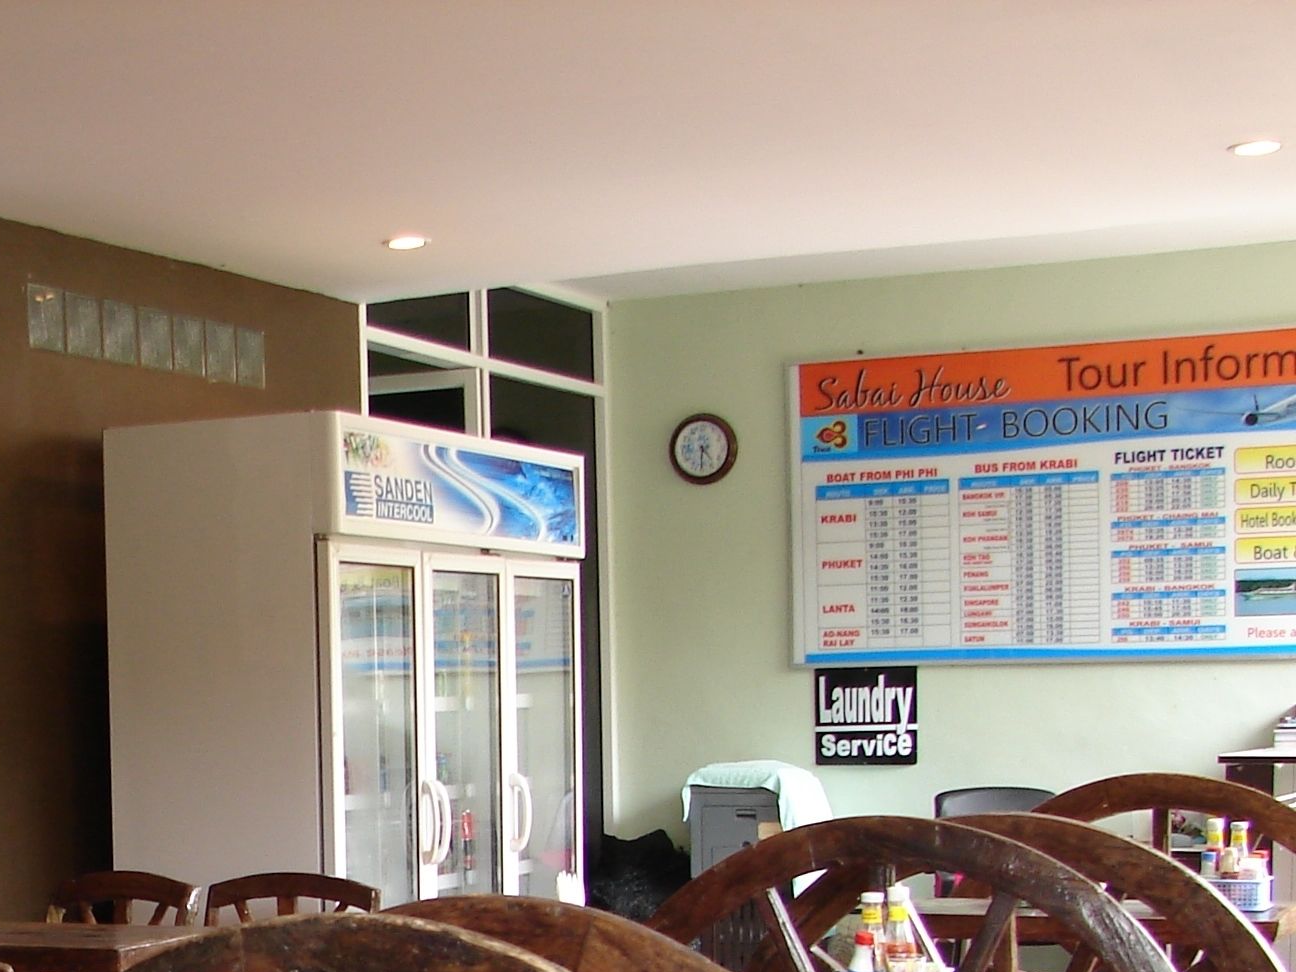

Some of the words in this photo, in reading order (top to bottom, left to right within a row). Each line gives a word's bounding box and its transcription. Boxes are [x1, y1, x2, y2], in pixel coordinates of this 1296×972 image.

[1058, 357, 1146, 391] Tour
[815, 369, 903, 410] Sabai
[909, 367, 1012, 406] House
[1002, 401, 1168, 439] BOOKING
[1114, 450, 1166, 464] FLIGHT
[1171, 446, 1224, 461] TICKET
[826, 472, 856, 483] BOAT
[860, 470, 891, 481] FROM
[895, 469, 914, 479] PHI
[918, 468, 938, 478] PHI
[975, 463, 999, 474] BUS
[1002, 461, 1036, 473] FROM
[1040, 459, 1078, 470] KRABI
[374, 474, 433, 505] SANDEN
[1250, 483, 1285, 501] Daily
[378, 500, 433, 522] INTERCOOL
[821, 514, 857, 524] KRABI
[1240, 513, 1268, 528] Hotel
[1253, 545, 1288, 560] Boat
[822, 560, 863, 569] PHUKET
[822, 604, 855, 614] LANTA
[1247, 627, 1286, 638] Please
[818, 674, 914, 735] Laundry
[821, 733, 912, 757] Service
